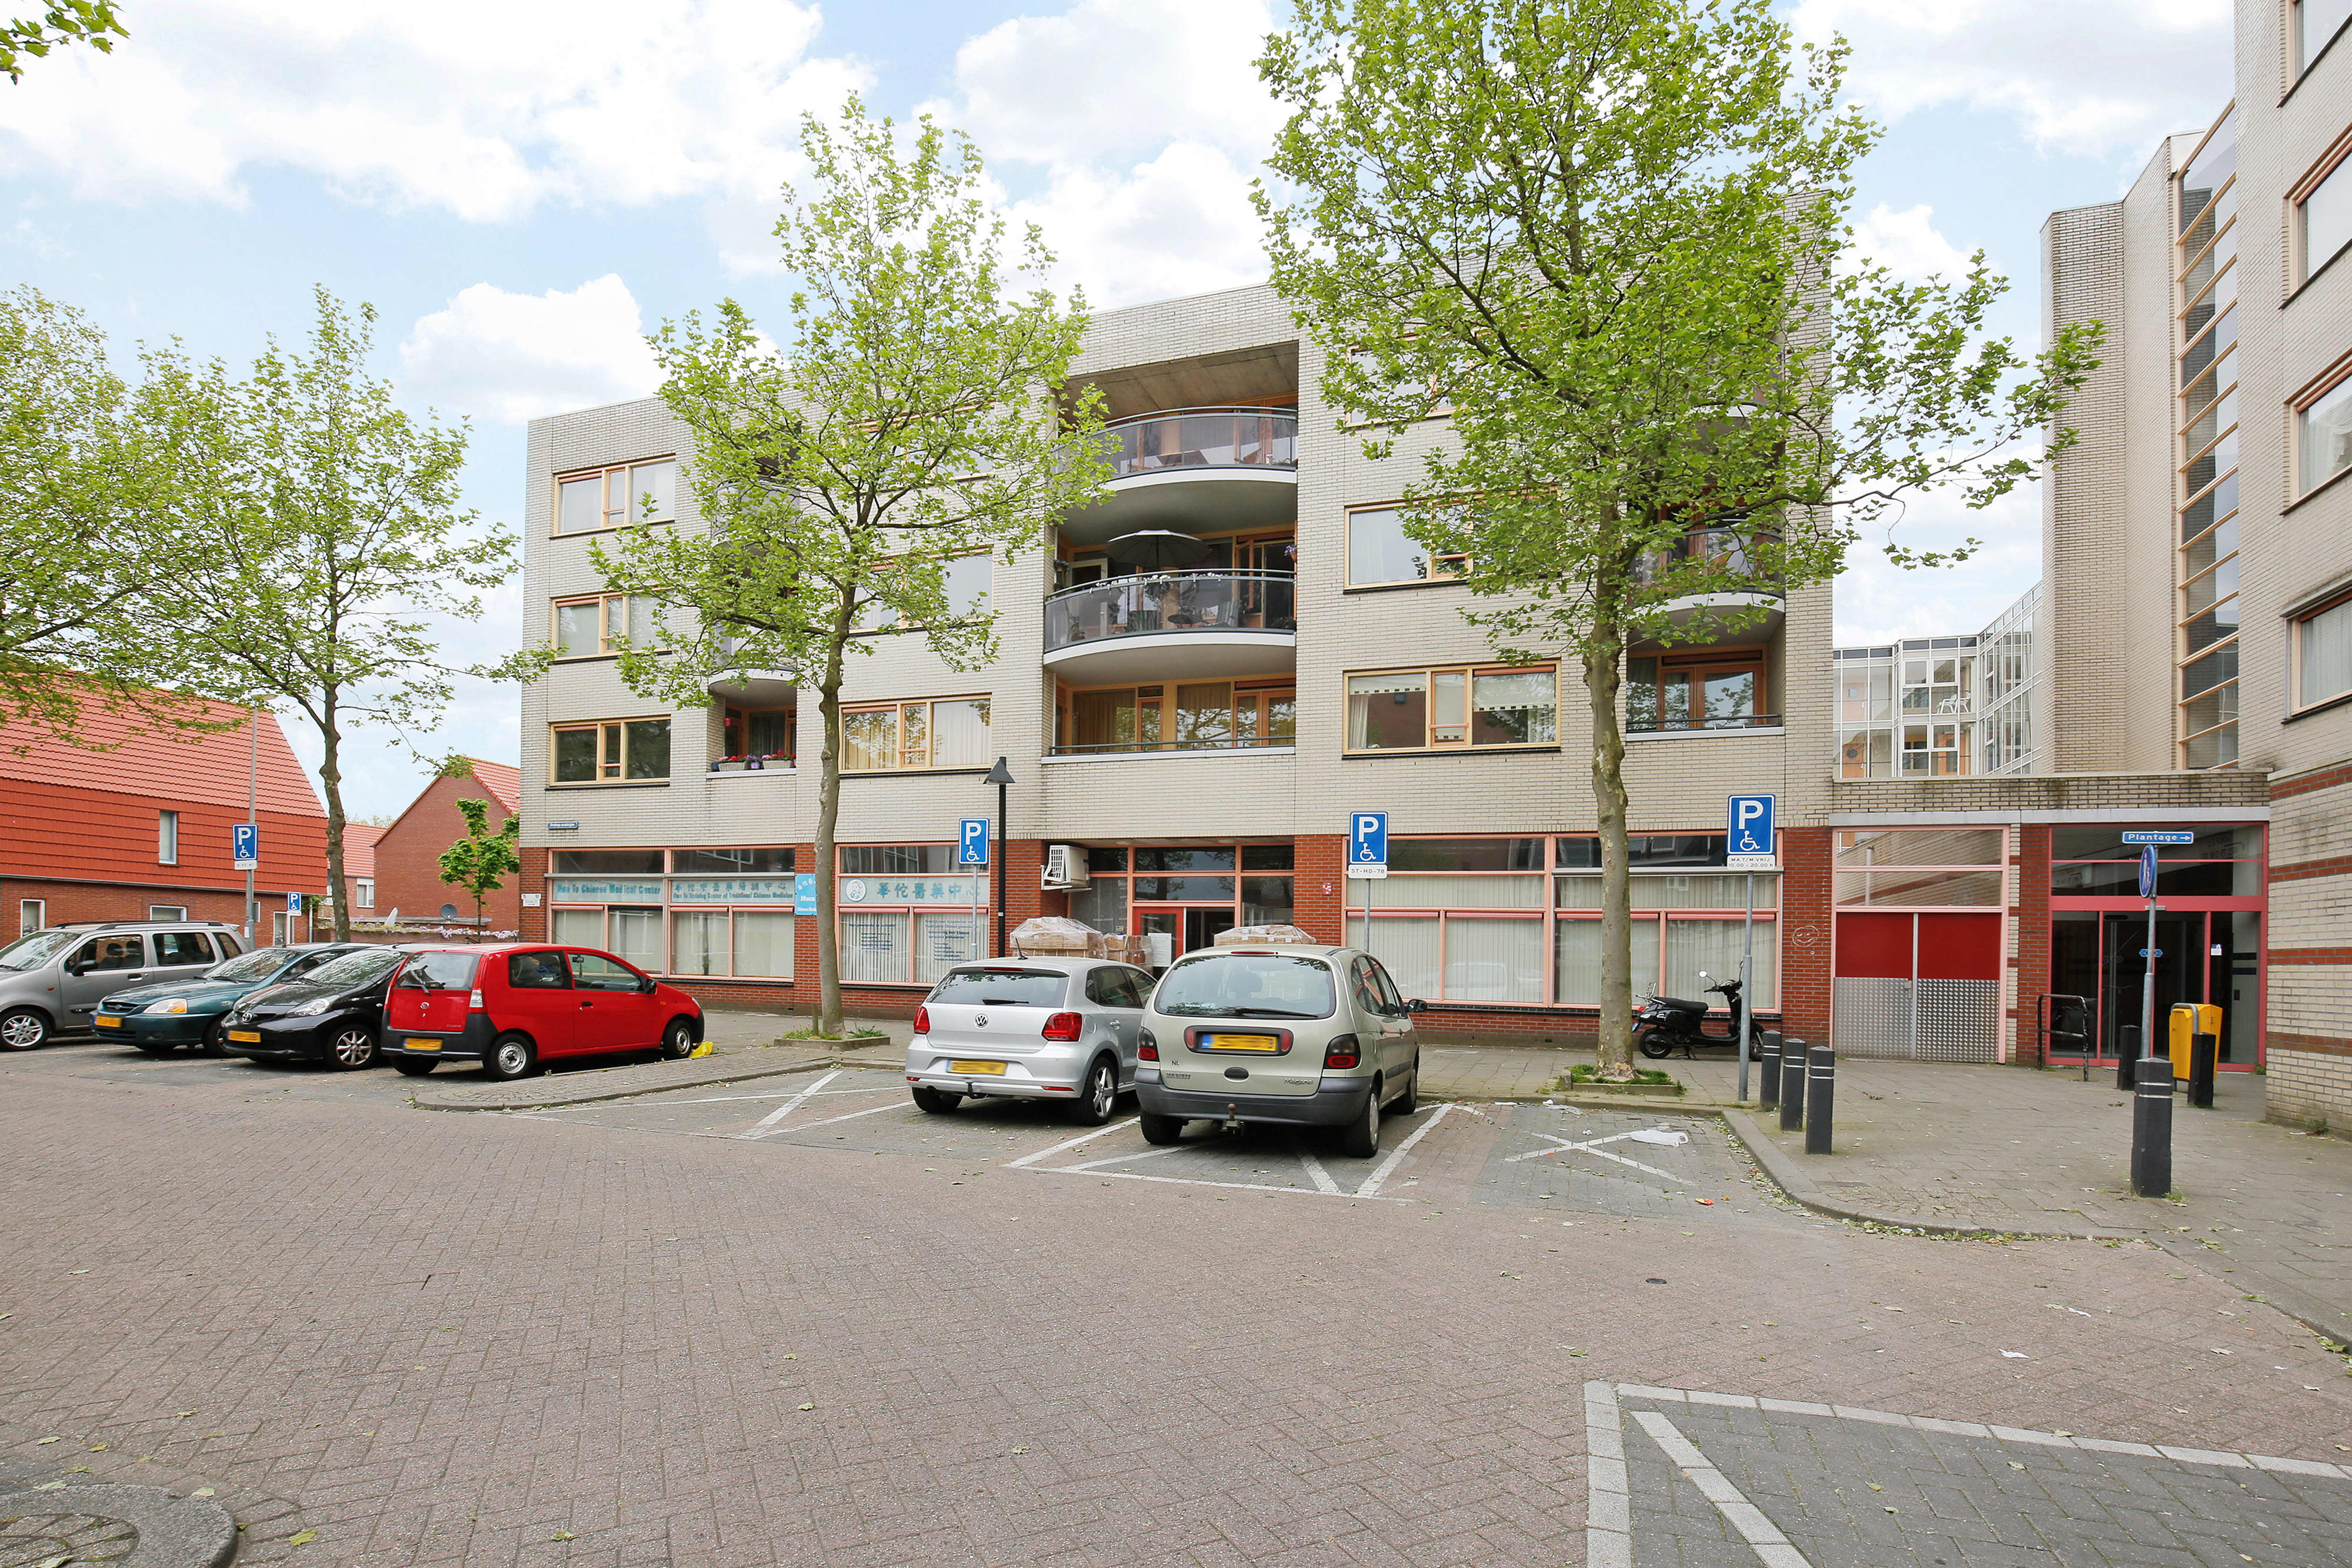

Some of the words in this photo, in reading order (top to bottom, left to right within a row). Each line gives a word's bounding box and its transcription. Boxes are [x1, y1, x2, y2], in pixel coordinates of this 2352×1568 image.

[1738, 800, 1763, 830] P
[238, 827, 252, 845] P
[965, 822, 982, 845] P
[1358, 816, 1379, 842] P
[2129, 834, 2177, 842] Plantage
[572, 884, 579, 893] To
[581, 884, 607, 893] Chinese
[290, 893, 299, 903] P
